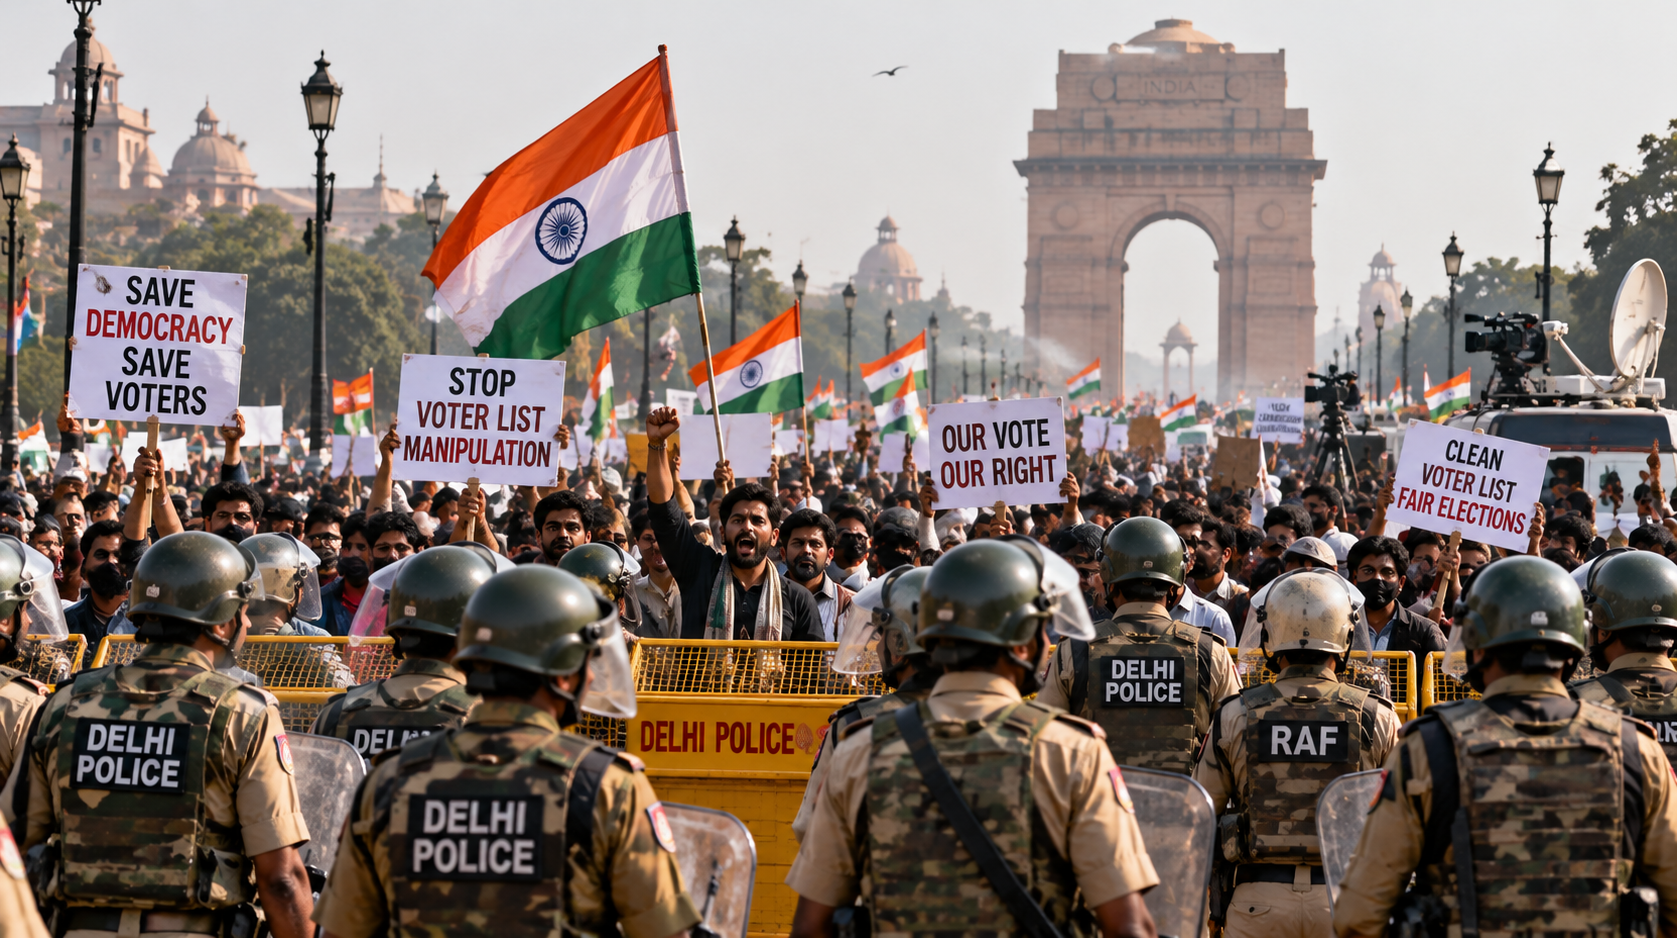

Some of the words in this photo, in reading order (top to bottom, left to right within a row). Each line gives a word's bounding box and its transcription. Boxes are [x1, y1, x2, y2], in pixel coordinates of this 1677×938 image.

[1143, 80, 1197, 95] INDIA
[126, 276, 195, 308] SAVE
[86, 309, 233, 345] DEMOCRACY
[122, 346, 191, 379] SAVE
[106, 381, 207, 415] VOTERS
[449, 367, 516, 397] STOP
[417, 401, 489, 430] VOTER
[497, 404, 545, 432] LIST
[403, 435, 551, 468] MANIPULATION
[942, 423, 986, 453] OUR
[992, 418, 1050, 449] VOTE
[1446, 439, 1504, 471] CLEAN
[940, 460, 985, 489] OUR
[992, 455, 1057, 486] RIGHT
[1422, 463, 1476, 492] VOTER
[1478, 476, 1517, 503] LIST
[1397, 487, 1435, 514] FAIR
[1437, 496, 1527, 535] ELECTIONS
[1112, 659, 1175, 680] DELHI
[1106, 682, 1181, 702] POLICE
[88, 724, 174, 755] DELHI
[353, 729, 431, 755] DEL
[640, 720, 705, 753] DELHI
[715, 721, 795, 755] POLICE
[1271, 725, 1339, 756] RAF
[77, 755, 180, 788] POLICE
[423, 800, 526, 835] DELHI
[413, 839, 535, 874] POLICE
